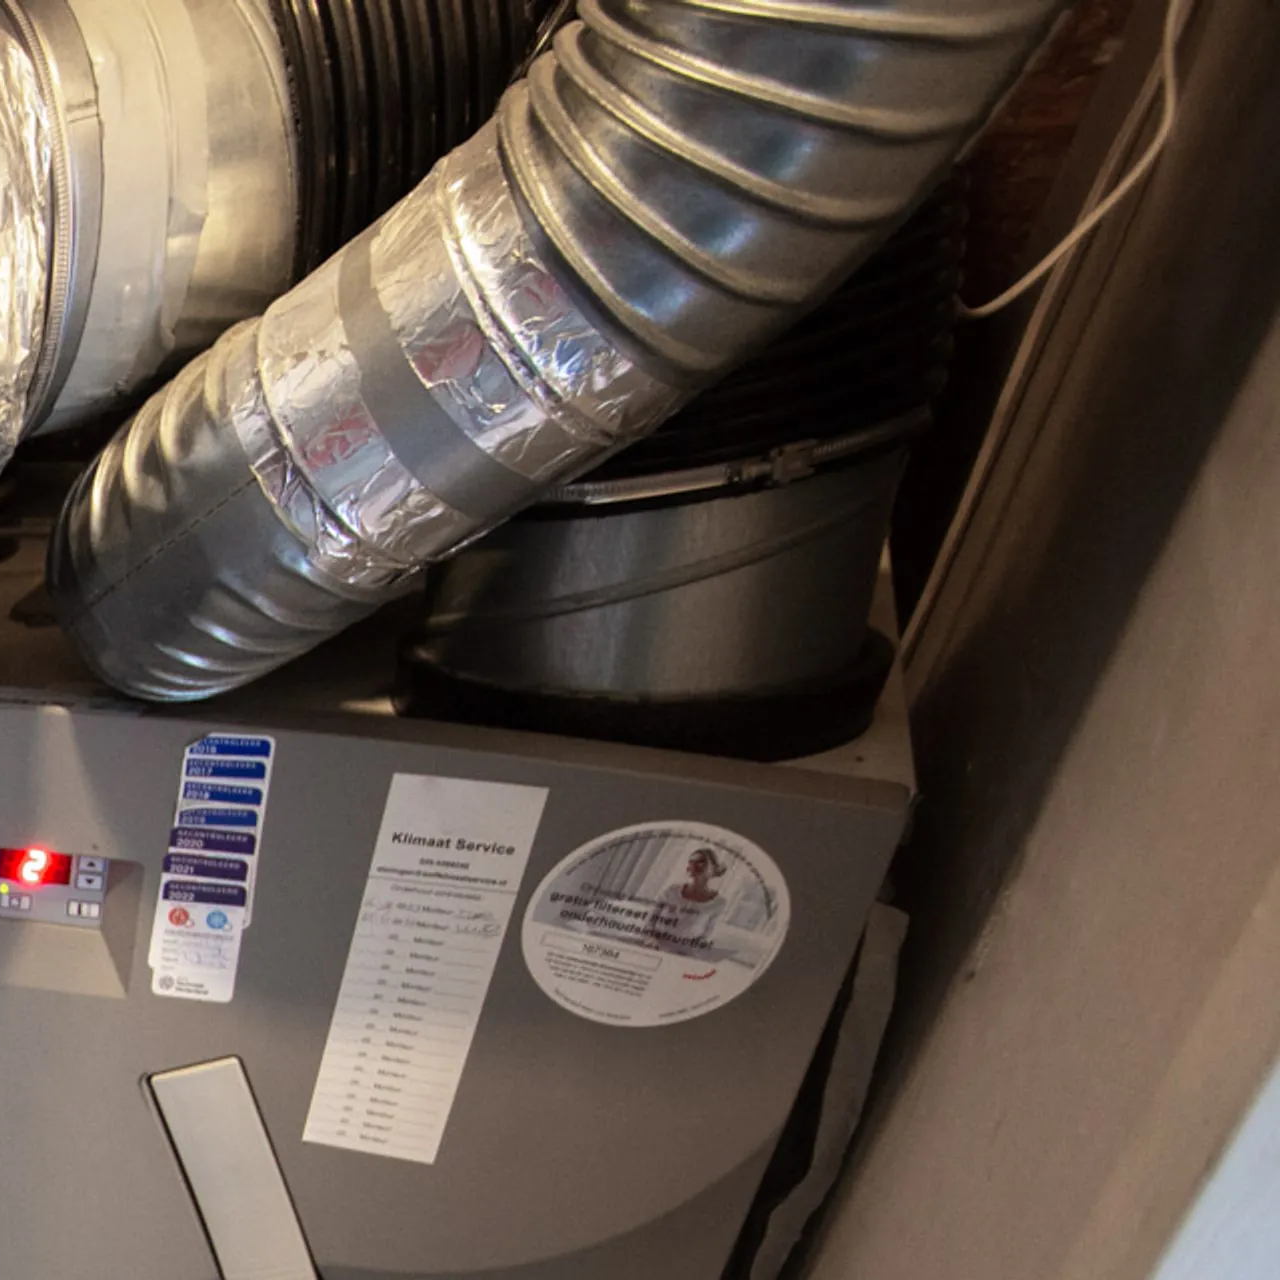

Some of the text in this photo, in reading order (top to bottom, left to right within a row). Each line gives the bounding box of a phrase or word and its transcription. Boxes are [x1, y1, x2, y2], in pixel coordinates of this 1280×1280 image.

[175, 838, 204, 849] 2020
[391, 831, 516, 856] Klimaat Service
[22, 849, 47, 882] 2
[169, 863, 195, 874] 2021
[168, 890, 196, 901] 2022
